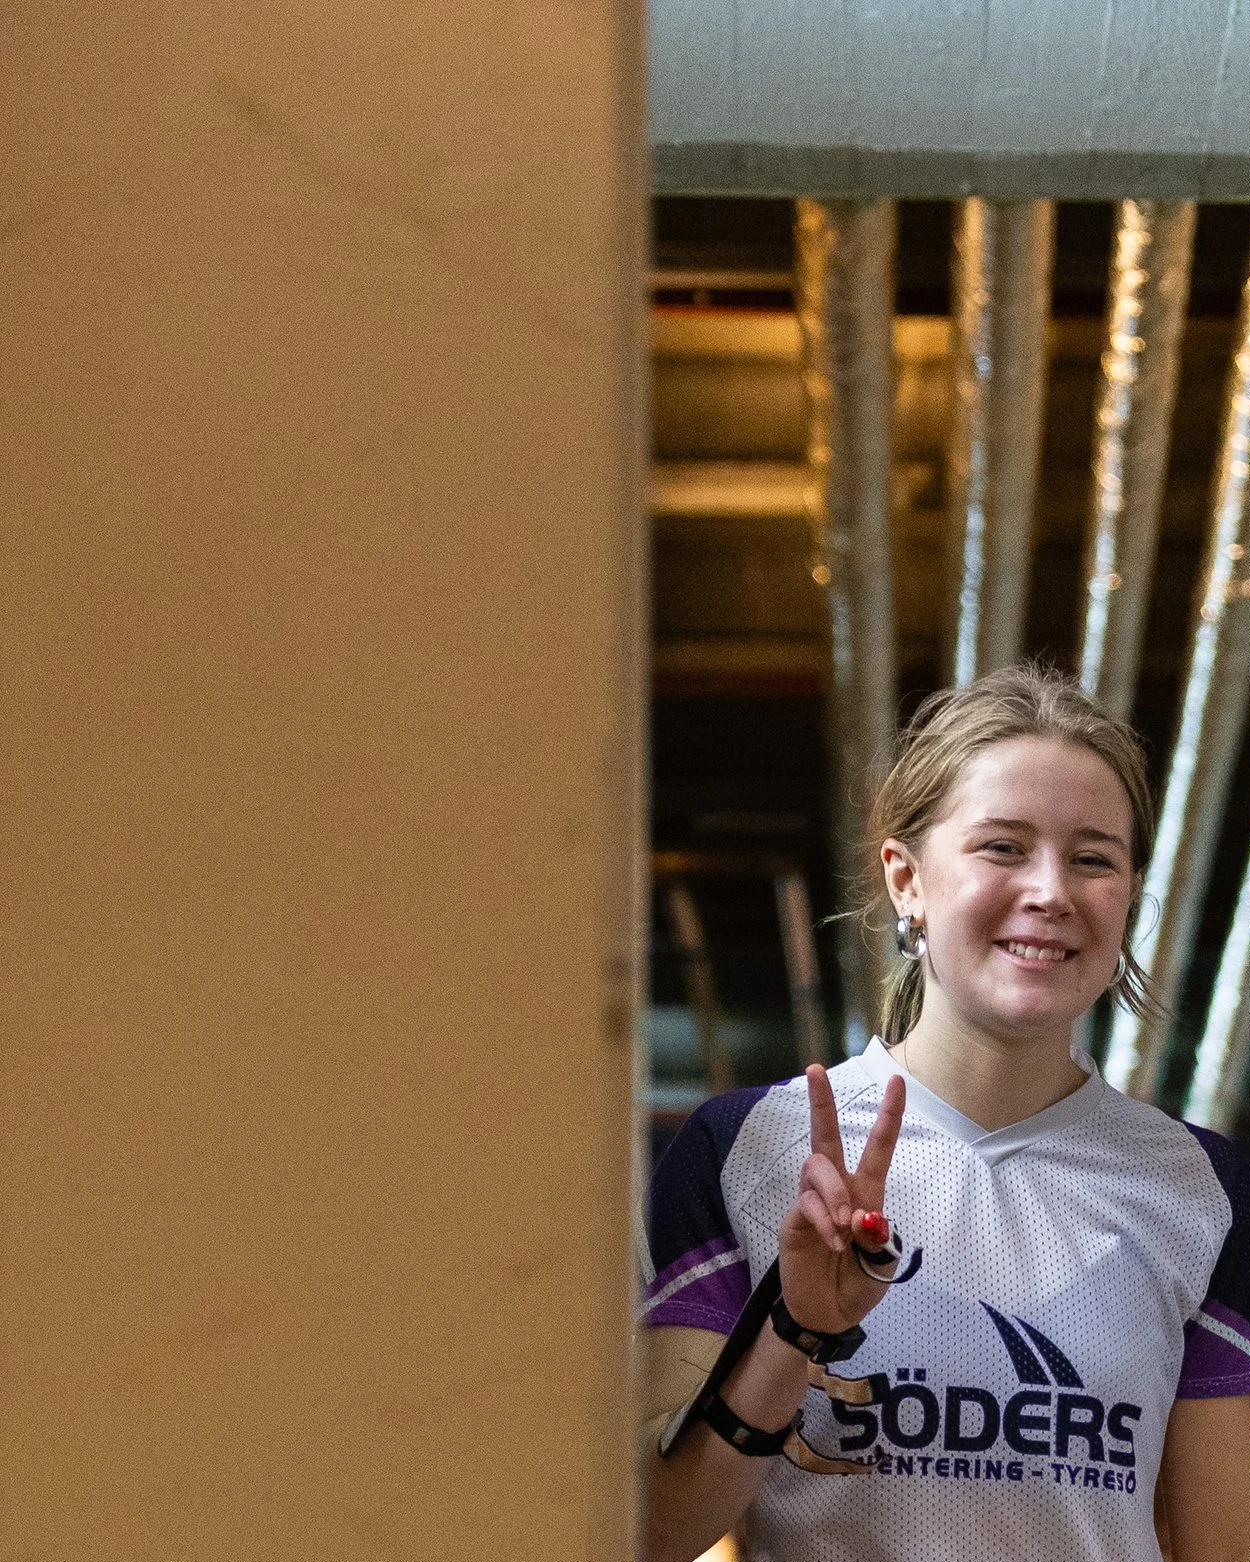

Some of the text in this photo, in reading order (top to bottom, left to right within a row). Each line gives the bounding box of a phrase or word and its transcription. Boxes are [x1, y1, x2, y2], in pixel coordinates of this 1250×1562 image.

[831, 1367, 1142, 1467] SÖDERS
[855, 1453, 1024, 1482] ENTERING
[1050, 1462, 1137, 1495] TYRESÖ
